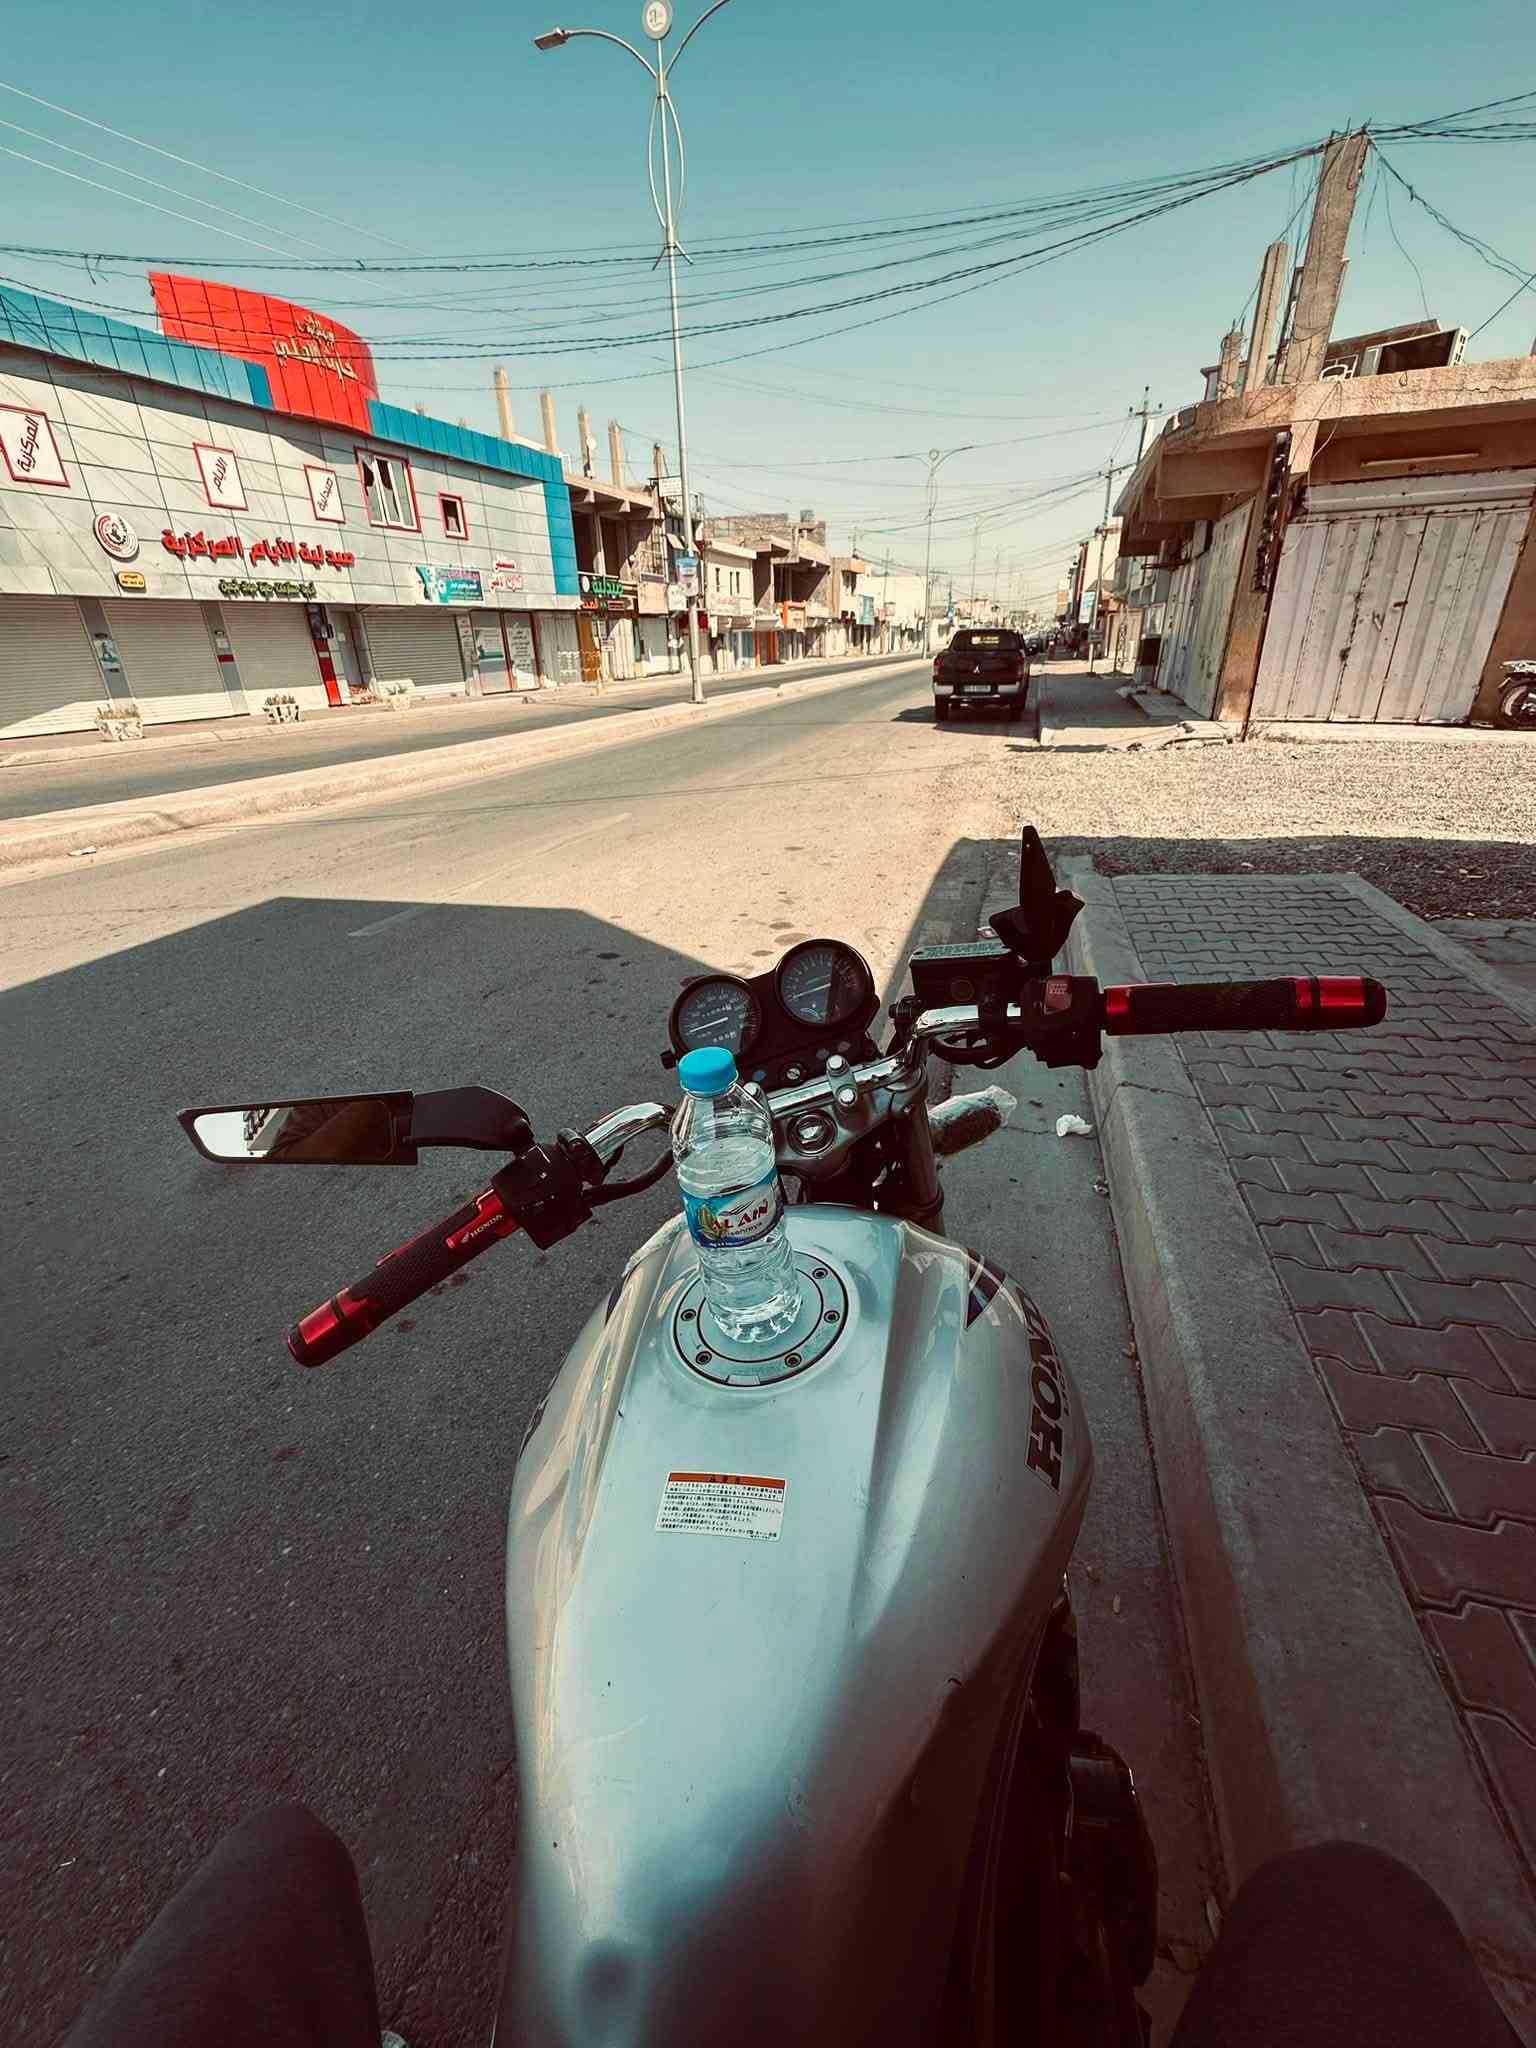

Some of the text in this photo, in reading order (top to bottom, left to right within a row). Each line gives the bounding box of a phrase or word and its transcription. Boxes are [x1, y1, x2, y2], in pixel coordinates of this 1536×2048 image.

[17, 415, 39, 473] المركزية
[161, 529, 244, 564] المركزية
[298, 542, 355, 571] صيدلية
[592, 576, 625, 598] صيدلية
[737, 1198, 769, 1227] AIN
